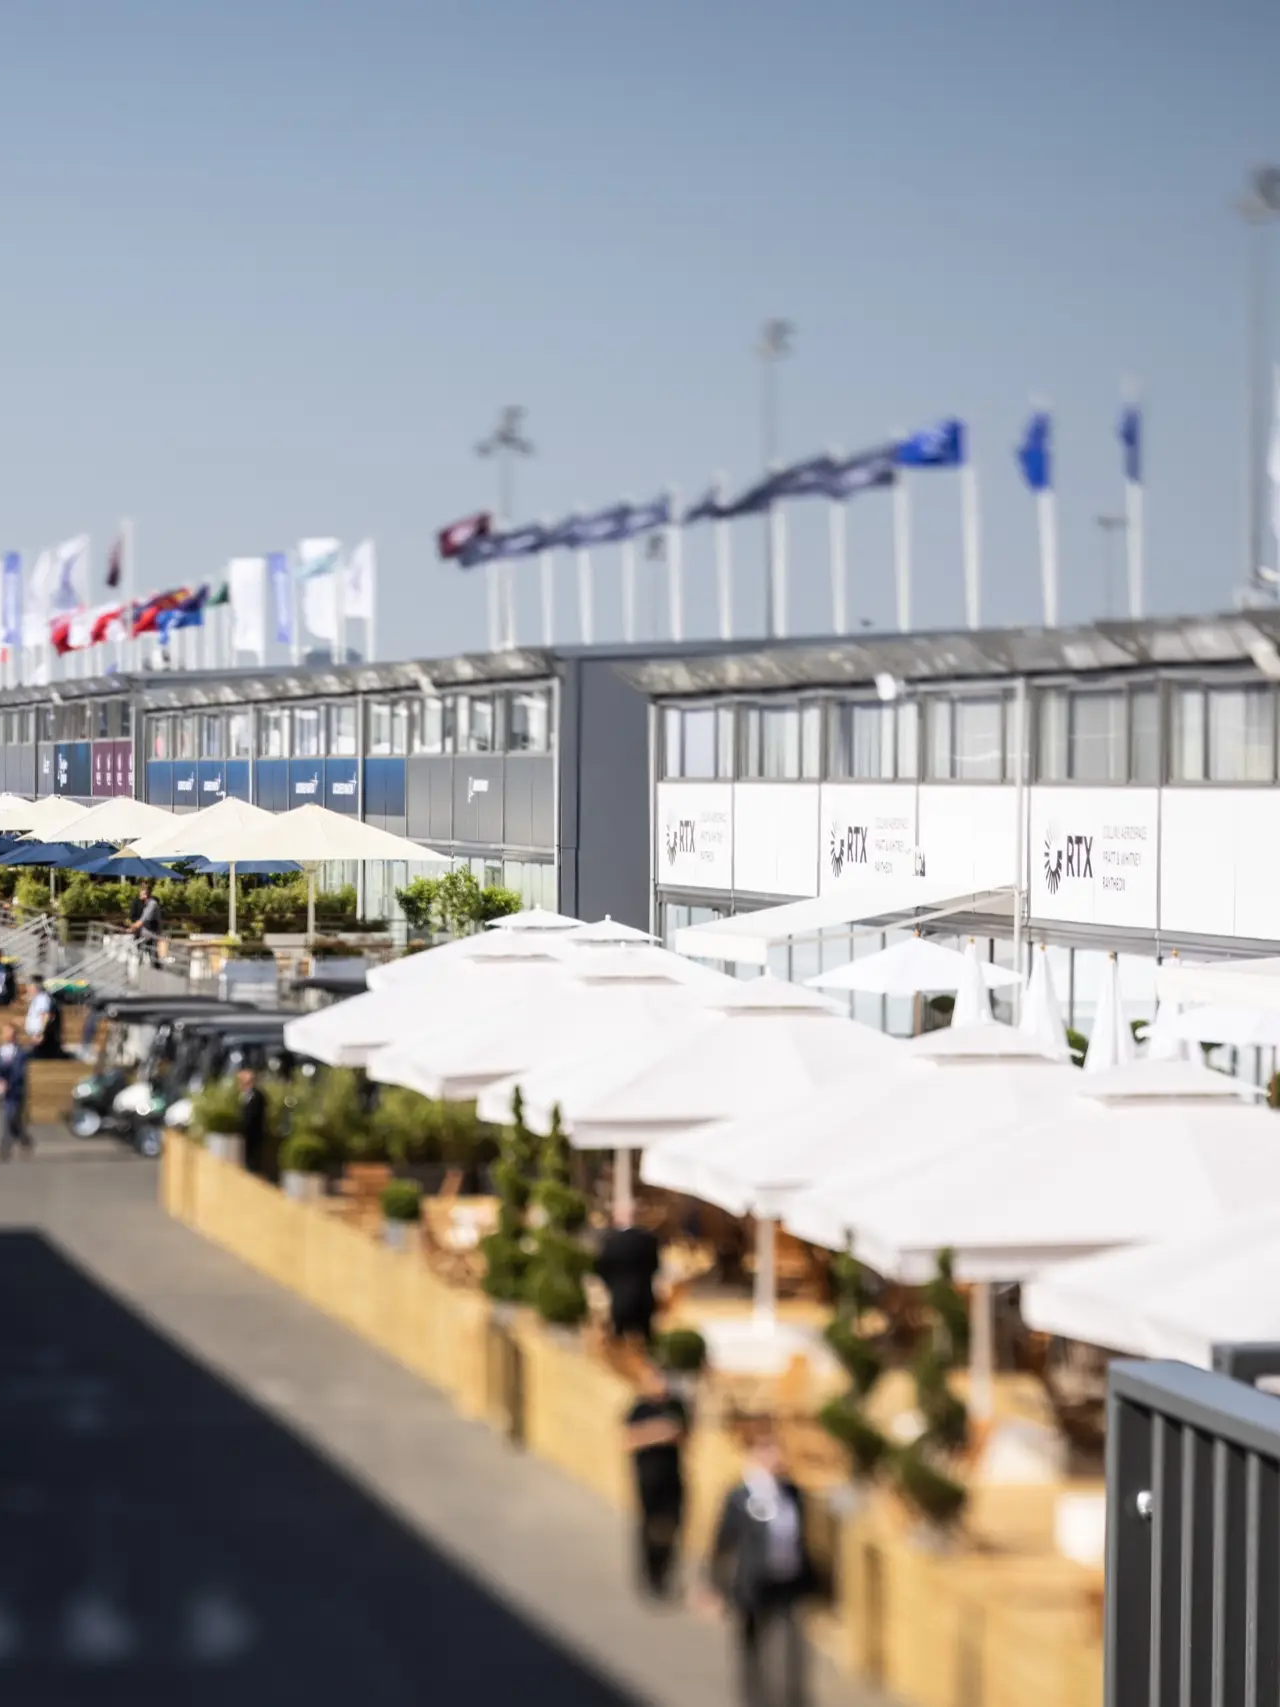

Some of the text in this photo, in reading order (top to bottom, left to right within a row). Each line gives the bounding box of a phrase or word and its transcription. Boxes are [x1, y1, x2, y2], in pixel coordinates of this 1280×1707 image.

[679, 819, 696, 853] RTX
[847, 826, 868, 863] RTX
[1066, 835, 1093, 878] RTX
